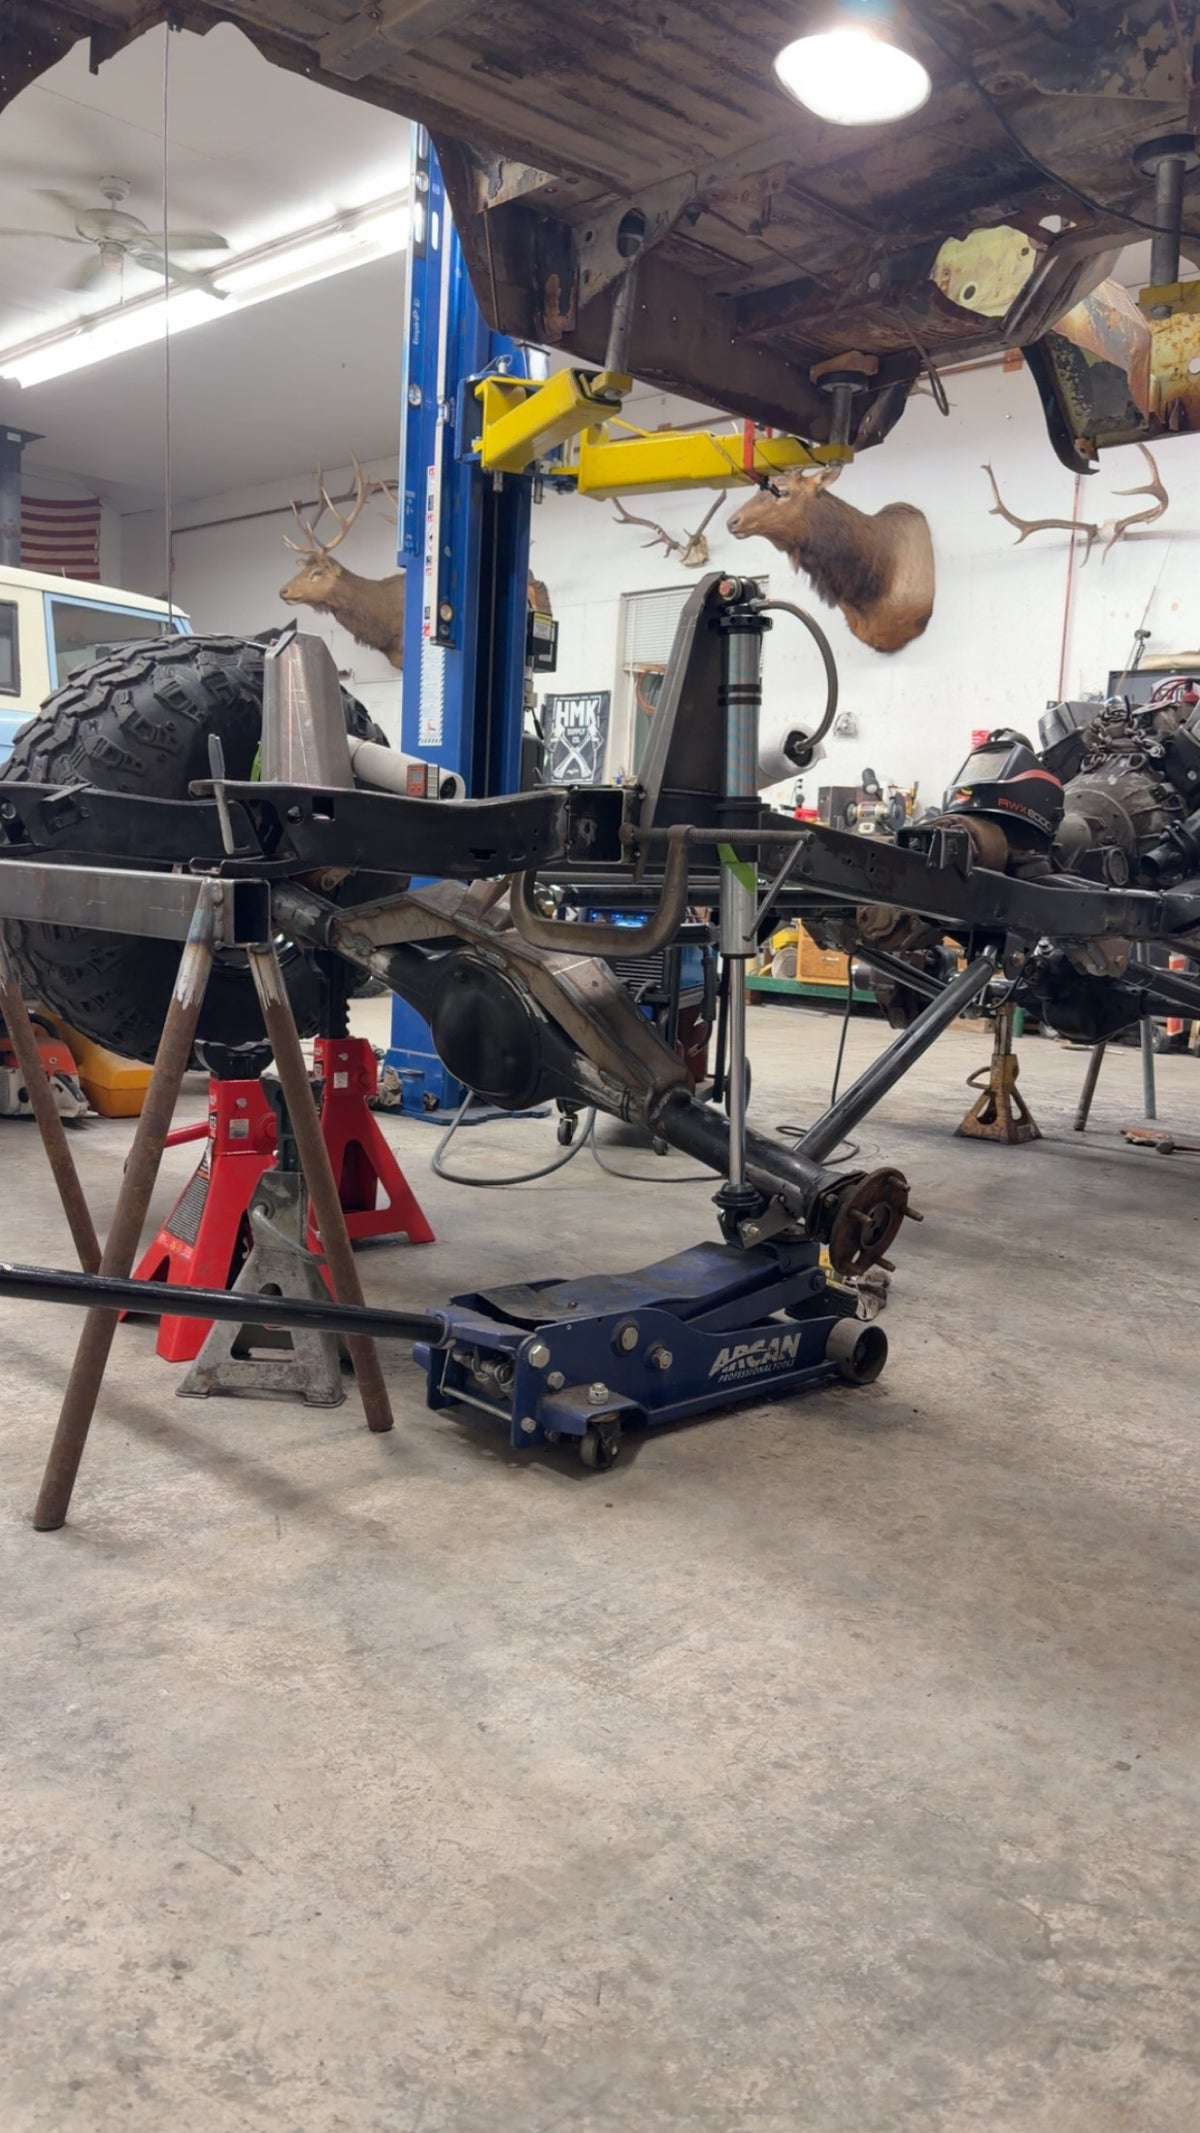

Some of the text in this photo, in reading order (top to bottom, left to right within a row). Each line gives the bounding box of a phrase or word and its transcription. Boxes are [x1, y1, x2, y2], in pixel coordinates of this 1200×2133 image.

[556, 700, 598, 727] HMK
[708, 1332, 801, 1377] ARCAN
[718, 1361, 772, 1383] PROFESSIONAL
